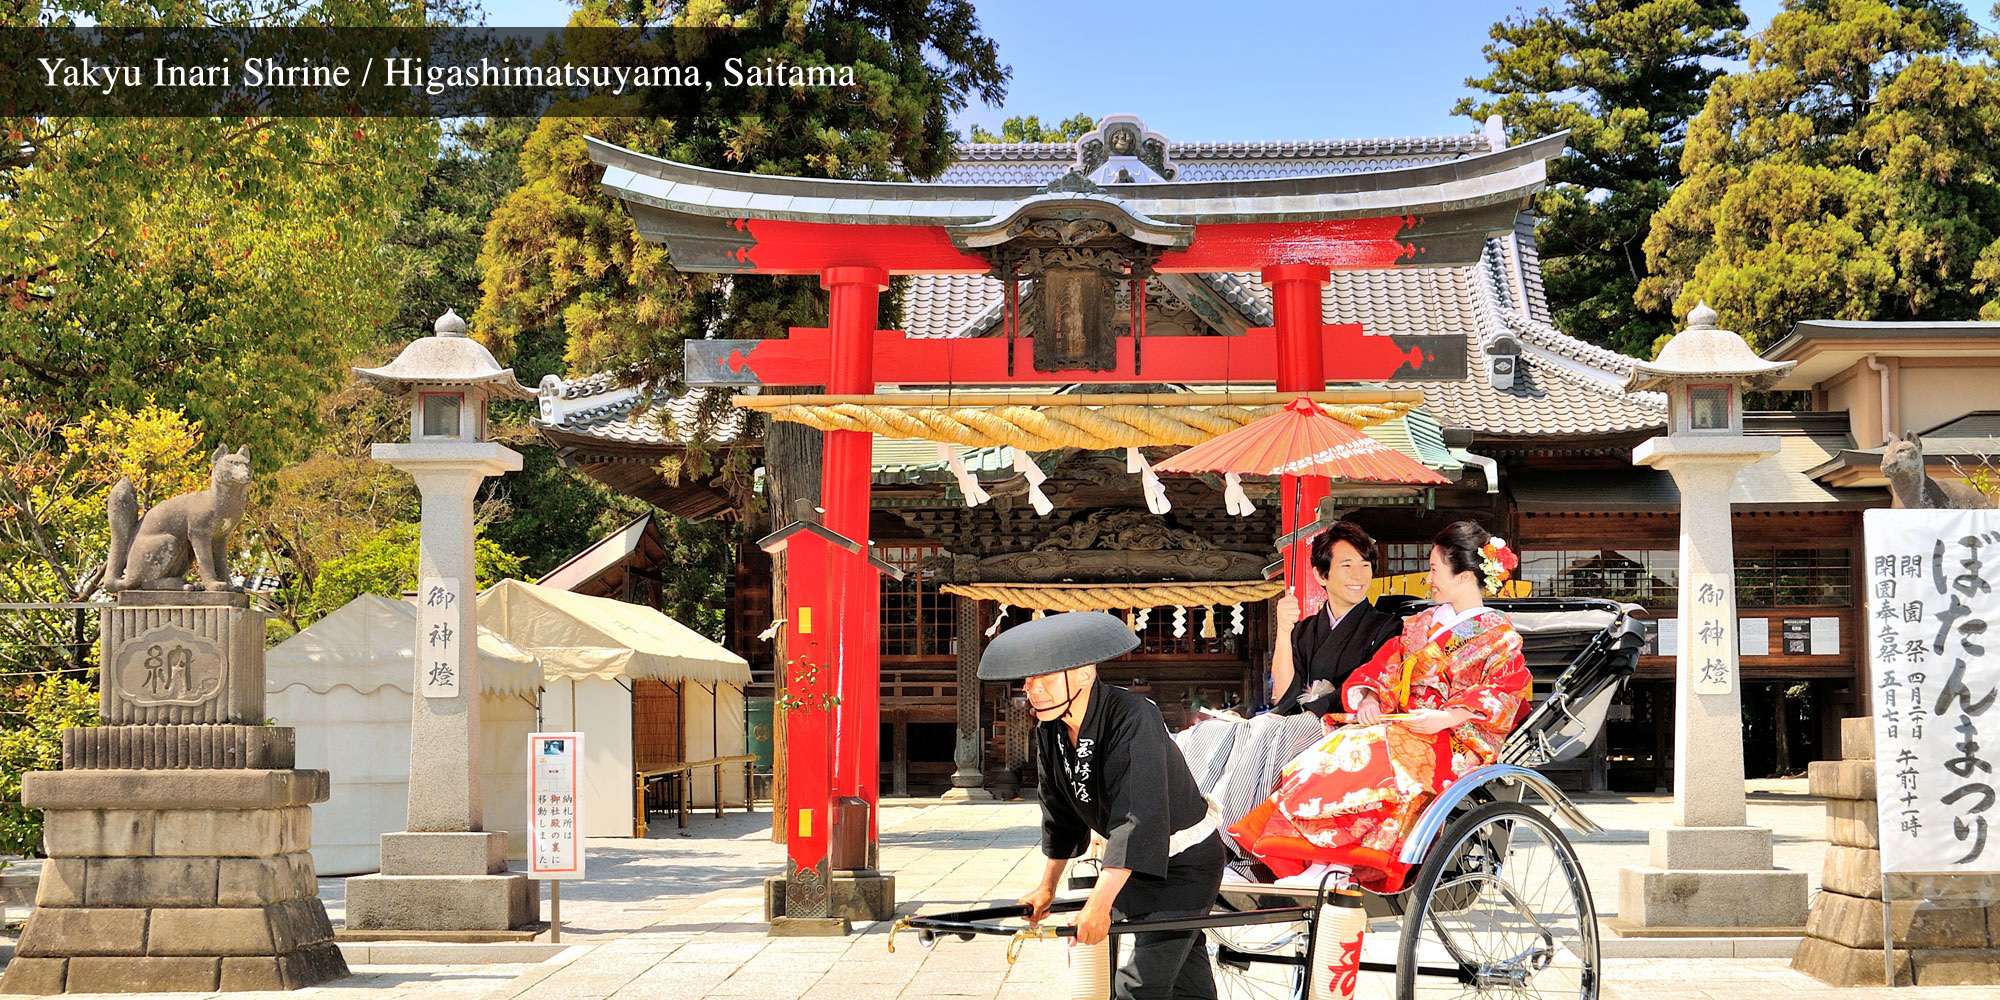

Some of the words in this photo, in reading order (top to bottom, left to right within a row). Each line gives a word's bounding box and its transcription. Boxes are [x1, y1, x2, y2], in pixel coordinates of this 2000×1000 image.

[427, 585, 456, 687] 御神燈
[1698, 582, 1730, 685] 御神燈
[1877, 668, 1903, 740] 五月七日
[1931, 529, 2000, 865] ぼたんまつり
[562, 794, 573, 840] 納札所は
[1895, 748, 1923, 839] 午前十一時
